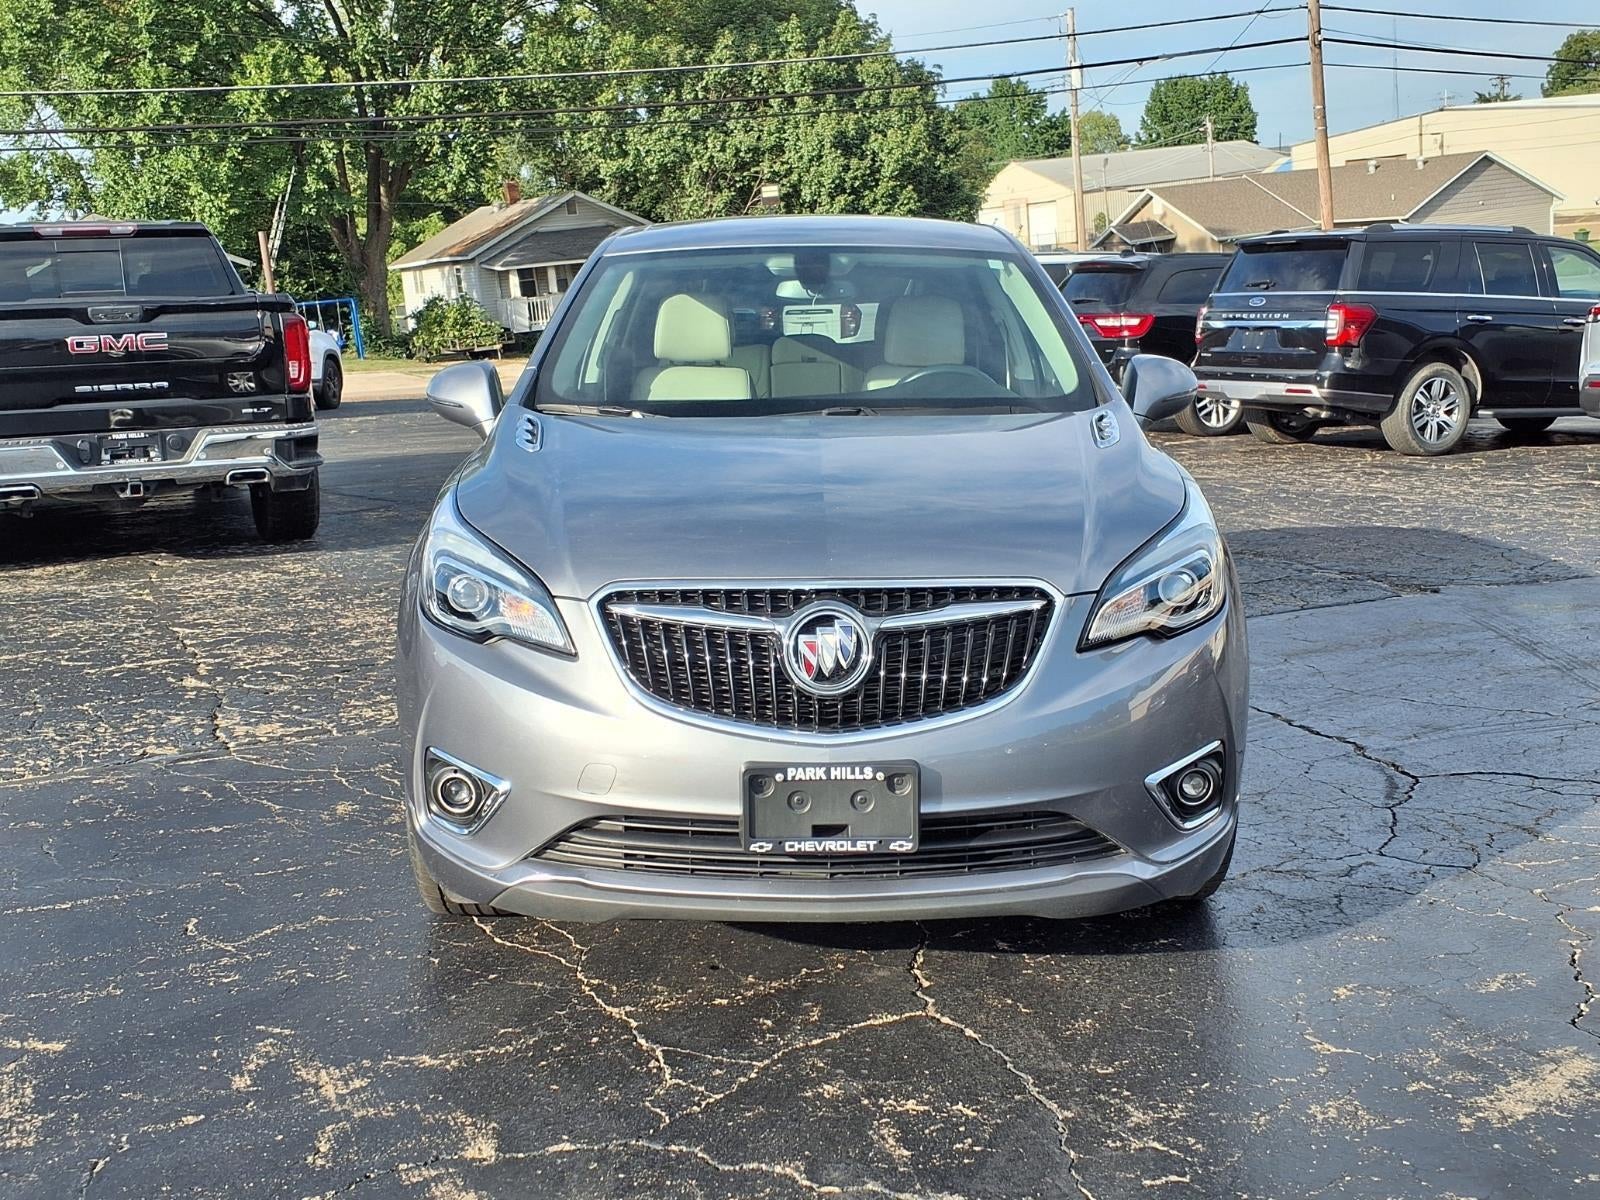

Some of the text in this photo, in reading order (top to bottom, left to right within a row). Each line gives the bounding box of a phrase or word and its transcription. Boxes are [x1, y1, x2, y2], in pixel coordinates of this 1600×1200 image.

[65, 332, 169, 354] GMC
[74, 381, 169, 393] SIERRA
[787, 766, 874, 781] PARK HILLS
[784, 840, 878, 852] CHEVROLET
